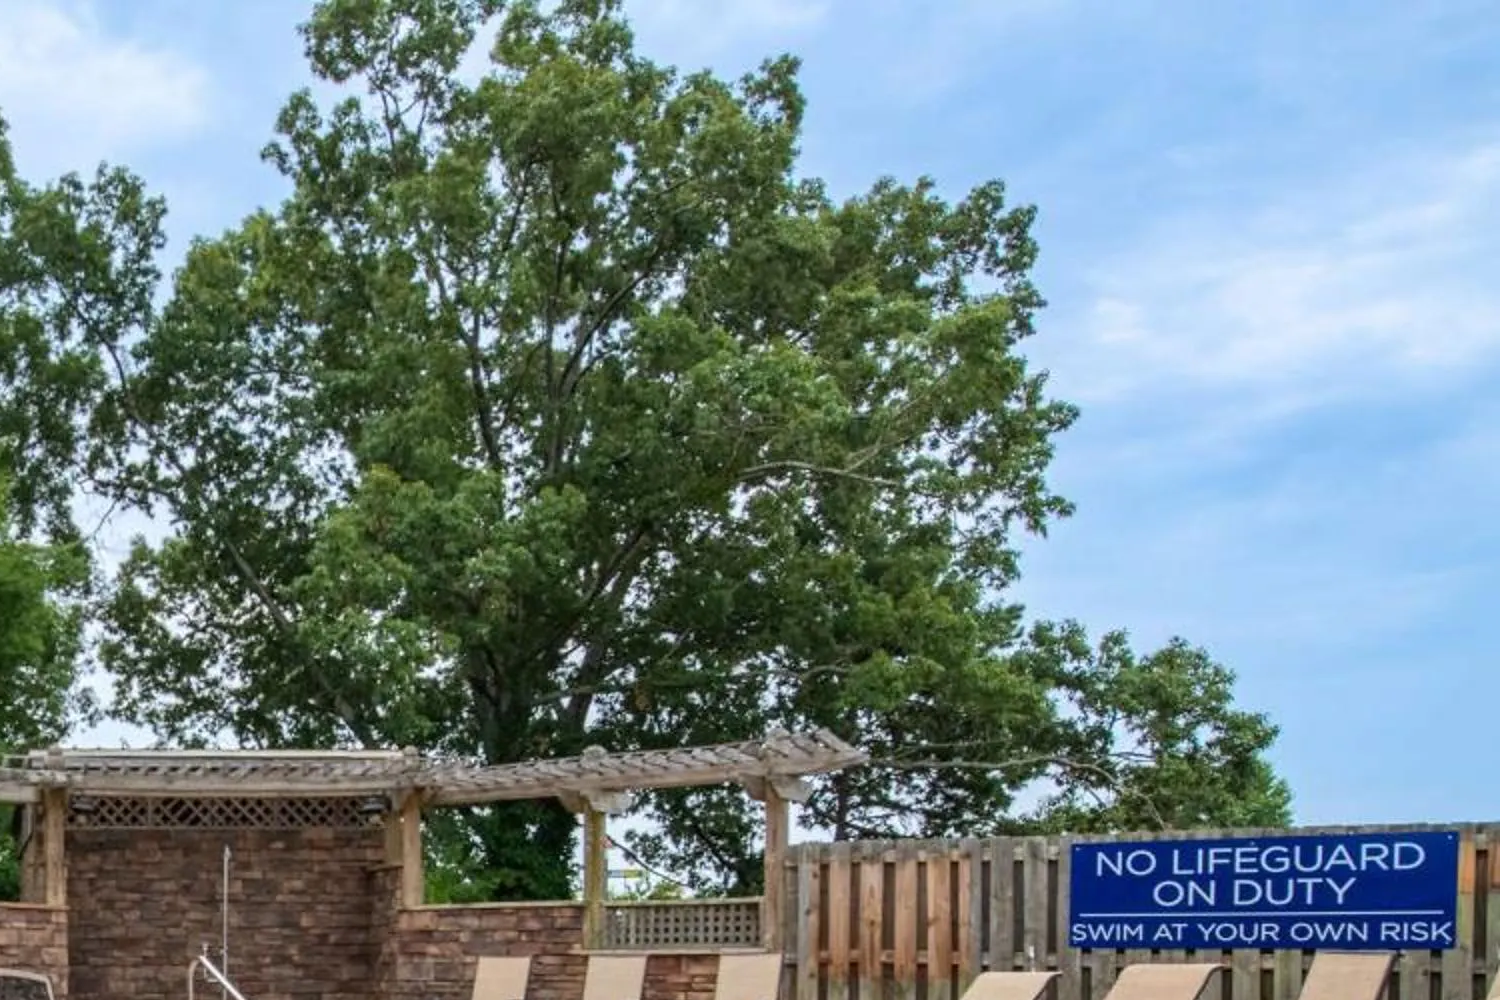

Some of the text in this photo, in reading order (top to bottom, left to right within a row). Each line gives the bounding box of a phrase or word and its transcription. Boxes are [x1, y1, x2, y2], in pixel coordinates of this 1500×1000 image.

[1097, 842, 1425, 876] NO LIFEGUARD
[1153, 877, 1356, 907] ON DUTY
[1072, 921, 1453, 942] SWIM AT YOUR OWN RISK
